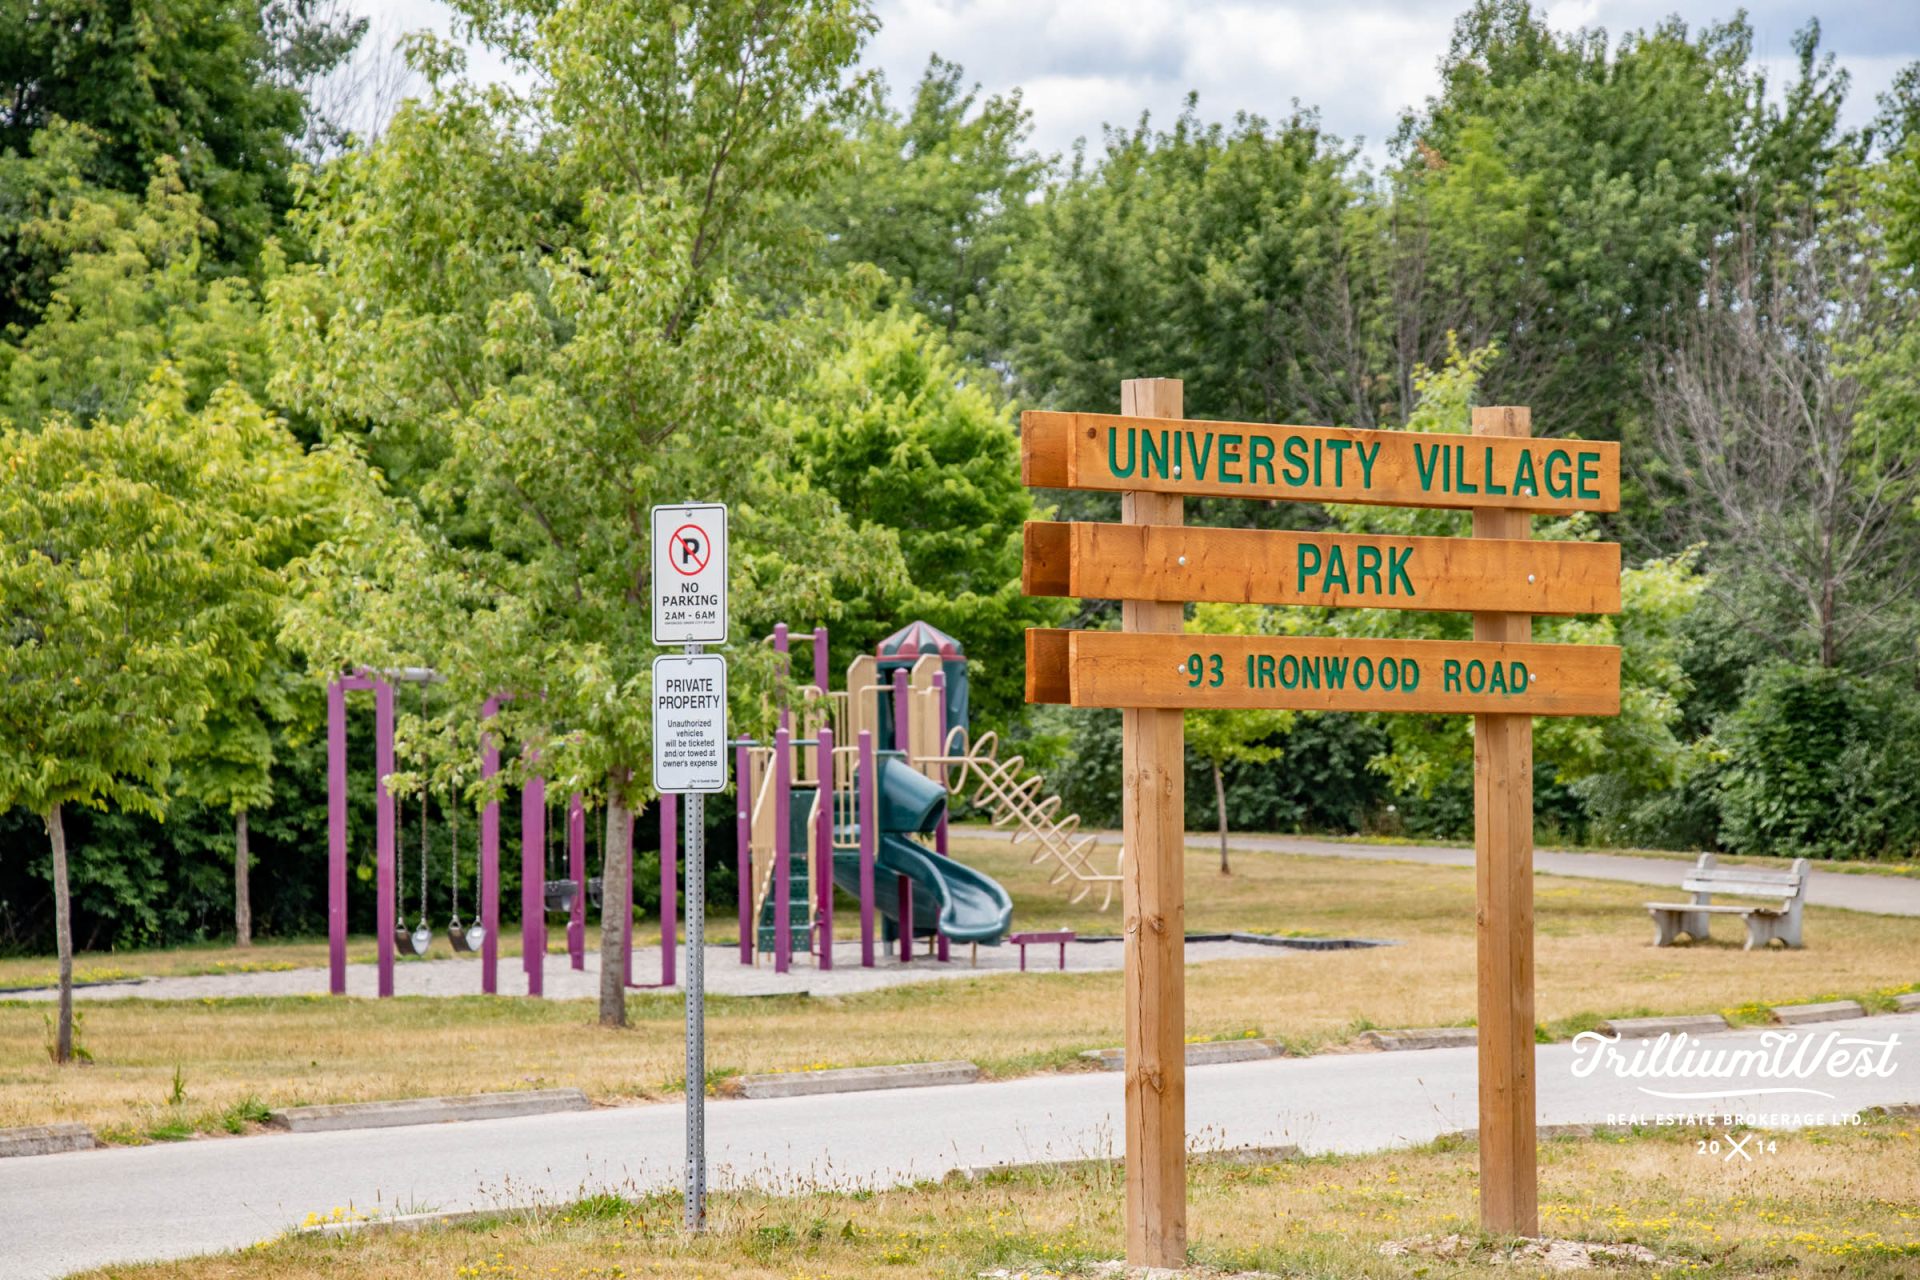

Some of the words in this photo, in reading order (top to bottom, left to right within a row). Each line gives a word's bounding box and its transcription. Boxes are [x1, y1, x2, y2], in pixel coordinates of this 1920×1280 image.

[1108, 427, 1381, 489] UNIVERSITY
[1414, 443, 1601, 499] VILLAGE
[1298, 543, 1416, 596] PARK
[681, 582, 699, 593] NO
[662, 595, 718, 607] PARKING
[664, 611, 686, 620] 2AM
[695, 610, 716, 620] 6AM
[1187, 653, 1224, 688] 93
[1247, 654, 1420, 691] IRONWOOD
[1444, 659, 1528, 693] ROAD
[666, 678, 713, 692] PRIVATE
[659, 695, 720, 709] PROPERTY
[667, 719, 712, 728] Unauthorized
[688, 739, 715, 747] ticketed
[664, 750, 686, 758] and/or
[687, 749, 708, 757] towed
[709, 749, 716, 757] at
[663, 759, 688, 767] owner's
[690, 760, 718, 768] expense
